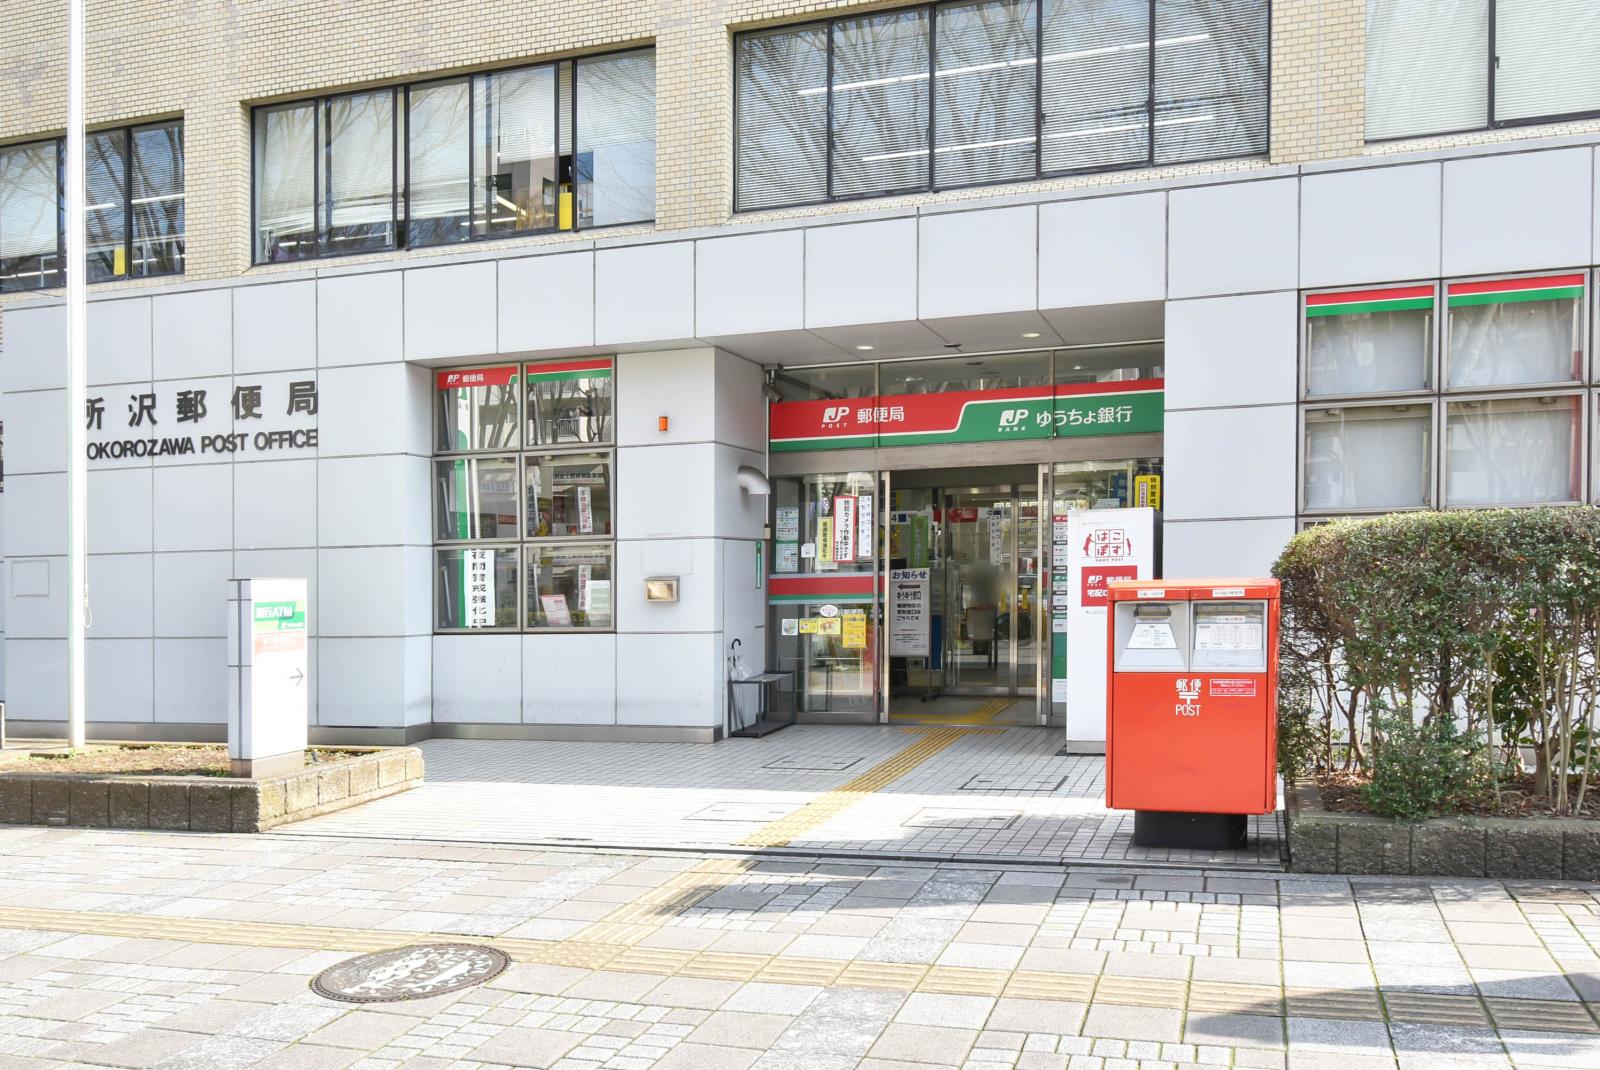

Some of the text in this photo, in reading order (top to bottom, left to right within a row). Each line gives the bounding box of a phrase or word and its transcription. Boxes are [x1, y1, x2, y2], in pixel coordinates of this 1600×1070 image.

[86, 380, 318, 430] 所沢郵便局
[856, 405, 906, 424] 郵便局
[1035, 405, 1134, 426] ゆうちょ銀行
[86, 428, 318, 461] OKOROZAWA POST OFFICE
[891, 570, 928, 580] お知らせ
[1175, 678, 1202, 693] 郵便
[1175, 704, 1202, 717] POST
